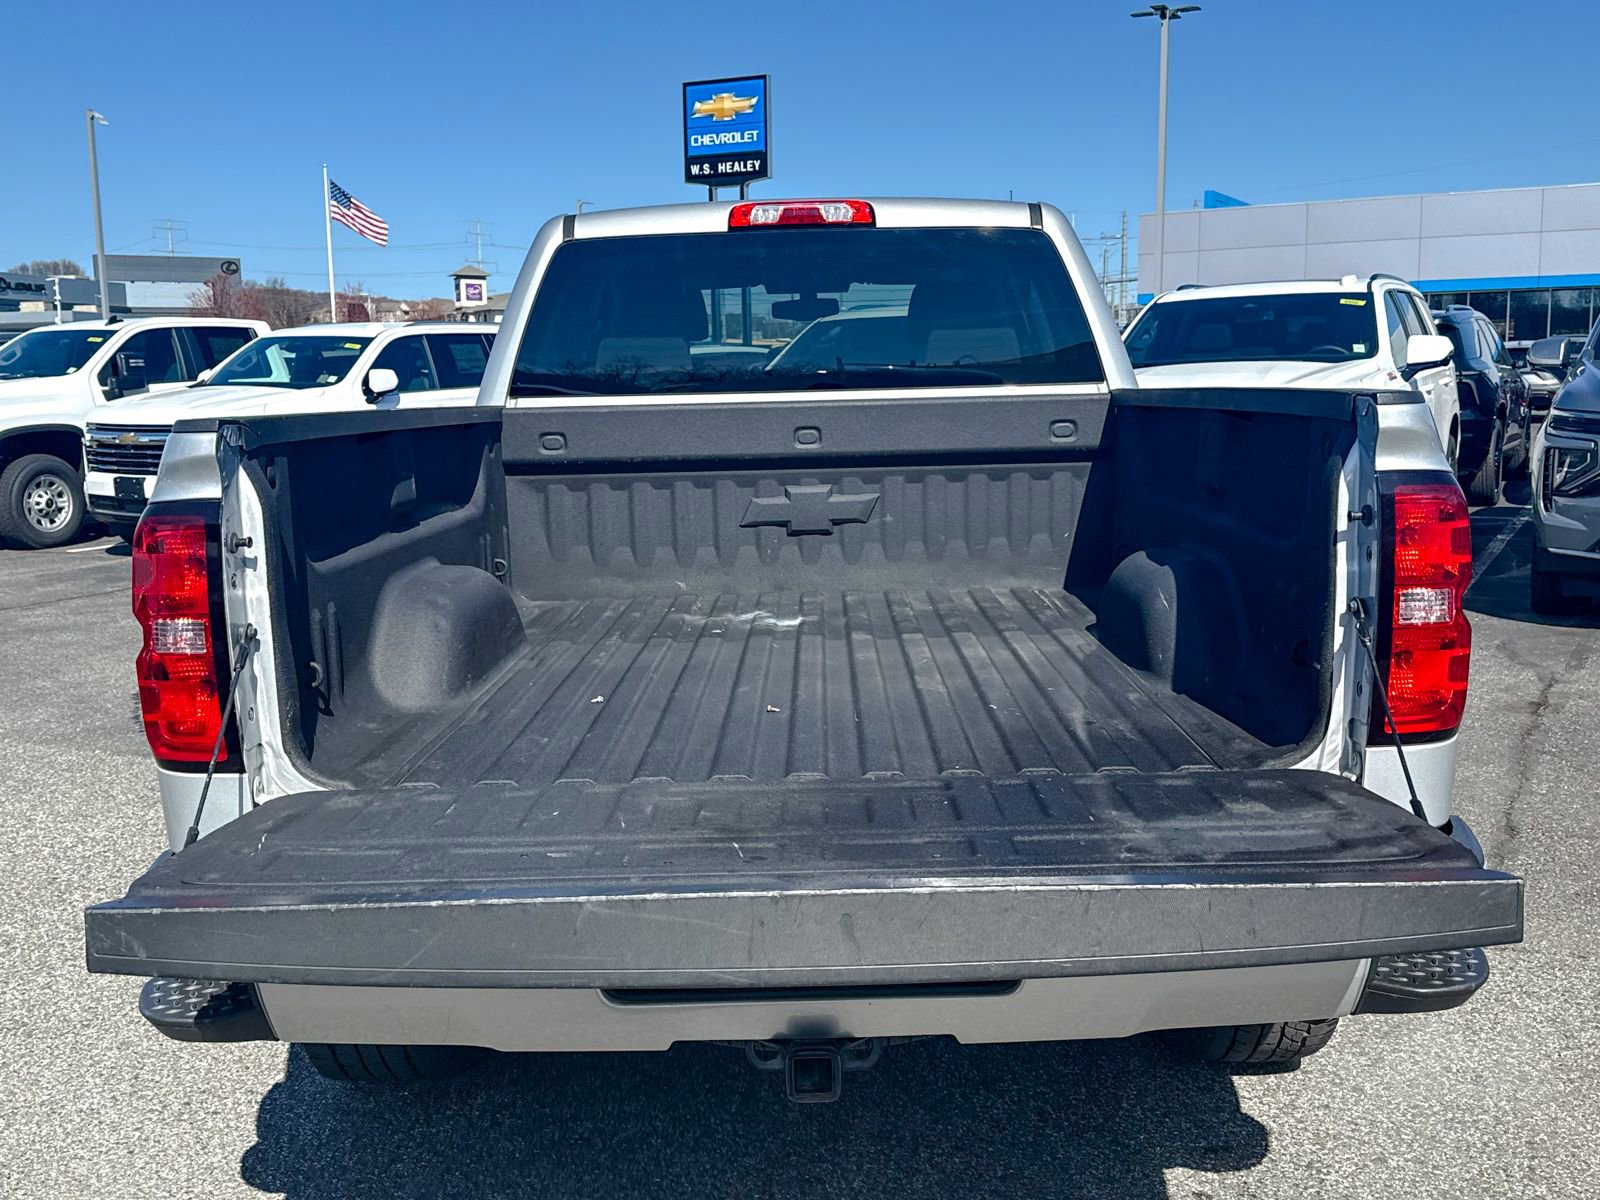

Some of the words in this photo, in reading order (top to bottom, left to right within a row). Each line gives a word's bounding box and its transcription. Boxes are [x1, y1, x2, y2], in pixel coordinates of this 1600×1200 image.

[690, 130, 759, 146] CHEVROLET
[690, 163, 714, 175] W.S.
[718, 160, 761, 173] HEALEY
